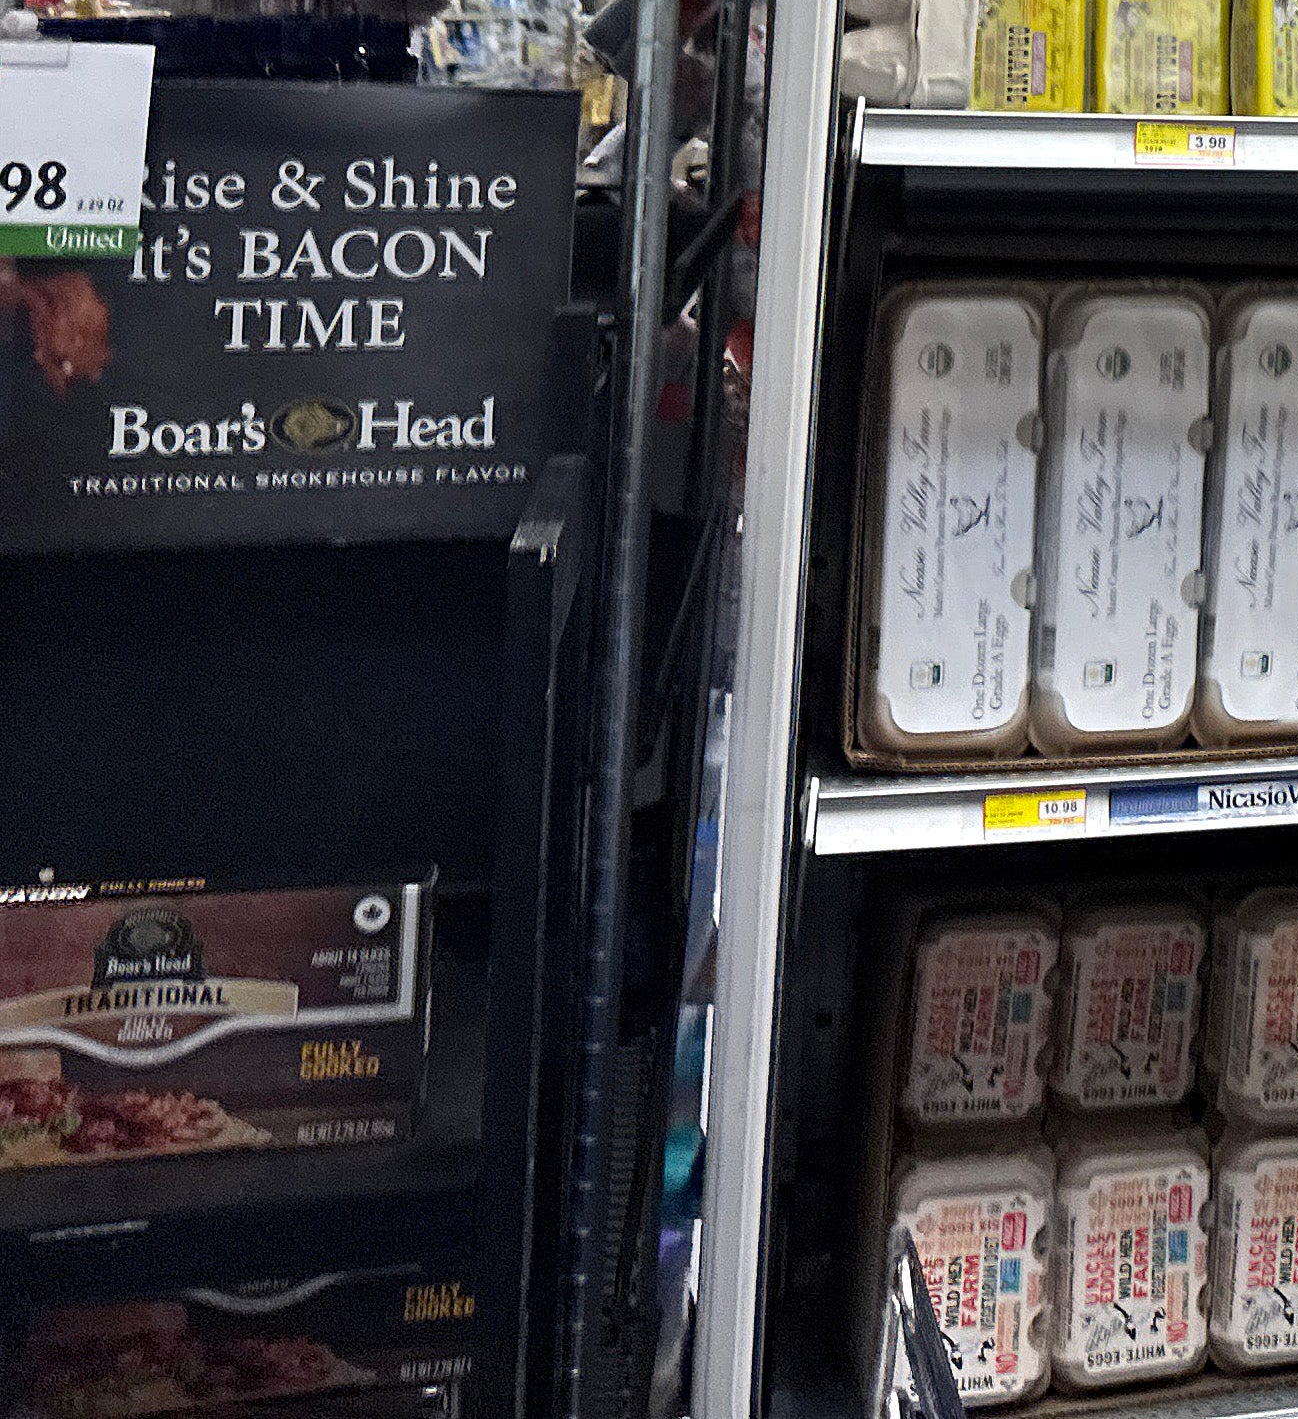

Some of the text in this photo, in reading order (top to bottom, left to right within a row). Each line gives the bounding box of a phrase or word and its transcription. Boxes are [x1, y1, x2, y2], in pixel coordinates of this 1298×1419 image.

[1195, 136, 1227, 150] 3.98
[271, 161, 324, 211] &
[344, 158, 519, 211] Shine
[47, 226, 123, 253] United
[238, 228, 493, 280] BACON
[214, 297, 406, 353] TIME
[109, 395, 497, 458] Boar's Head
[70, 461, 528, 497] TRADITIONAL SMOKEHOUSE FLAVOR
[1234, 468, 1267, 527] Valley
[899, 474, 935, 534] Valley
[1074, 474, 1107, 534] Valley
[972, 640, 987, 686] Dozen
[1141, 640, 1154, 686] Dozen
[972, 690, 985, 719] One
[989, 668, 1003, 709] Grade
[1140, 690, 1153, 719] One
[1157, 668, 1170, 710] Grade
[63, 985, 228, 1017] TRADITIONAL
[1085, 1233, 1099, 1305] UNCLE
[1133, 1227, 1149, 1298] FARM
[1245, 1217, 1261, 1287] UNCLE
[1277, 1249, 1291, 1284] WILD
[961, 1254, 979, 1327] FARM
[1119, 1261, 1132, 1300] WILD
[945, 1290, 960, 1328] WILD
[1087, 1344, 1166, 1368] WHITE EGGS
[957, 1375, 994, 1391] WHIT
